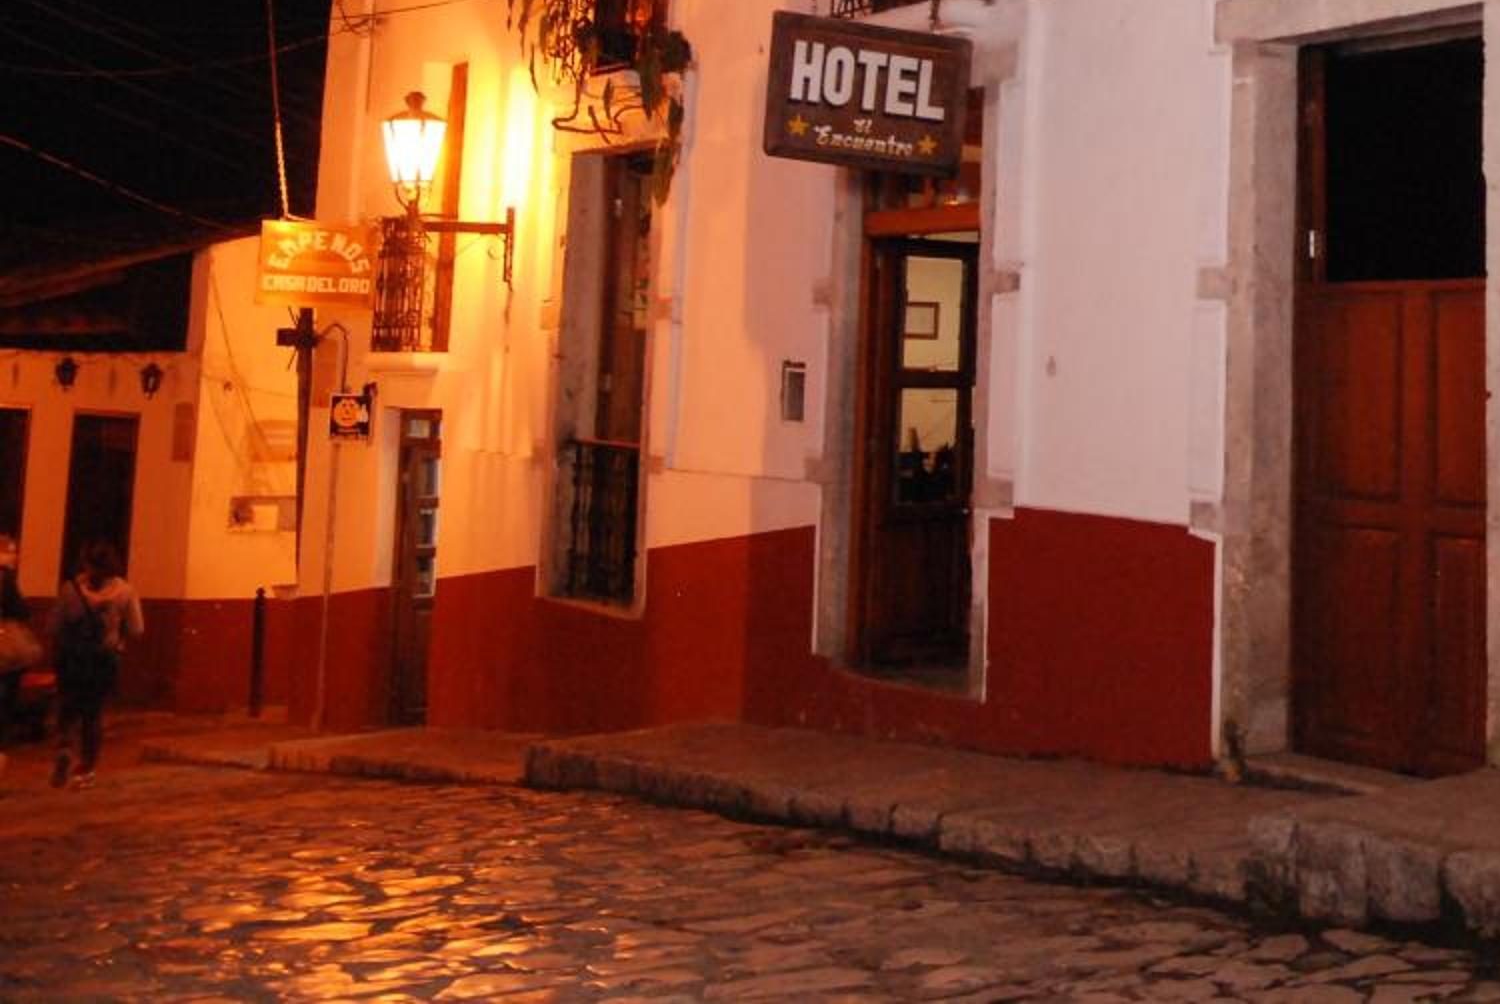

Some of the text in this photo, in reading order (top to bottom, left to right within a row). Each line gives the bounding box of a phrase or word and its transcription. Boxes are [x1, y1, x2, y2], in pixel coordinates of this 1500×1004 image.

[791, 41, 944, 120] HOTEL
[853, 119, 872, 133] El
[814, 125, 912, 155] Encuentro
[262, 275, 369, 294] CASA DEL ORO
